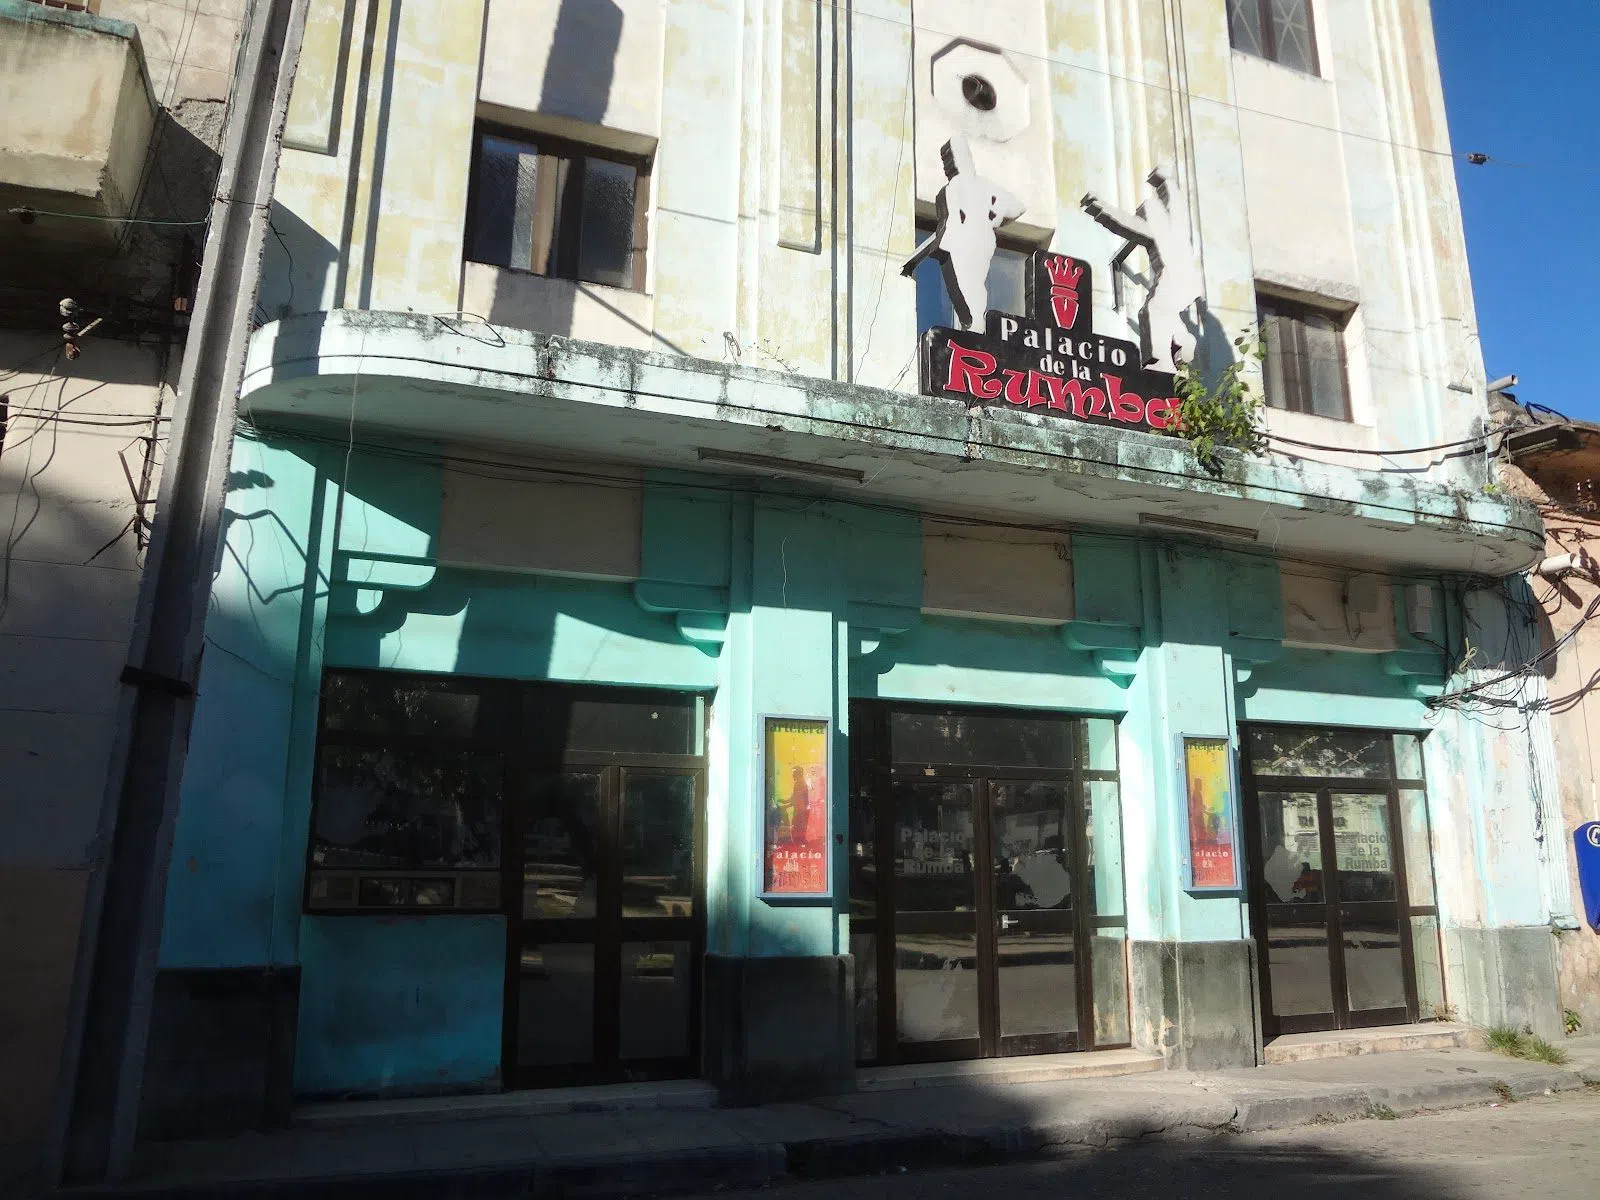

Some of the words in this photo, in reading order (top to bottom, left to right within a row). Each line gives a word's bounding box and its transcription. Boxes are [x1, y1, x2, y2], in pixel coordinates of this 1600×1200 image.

[1001, 317, 1126, 367] Palacio
[943, 339, 1189, 432] Rumba
[1040, 354, 1065, 376] de
[1072, 359, 1092, 382] la
[1369, 844, 1380, 857] la
